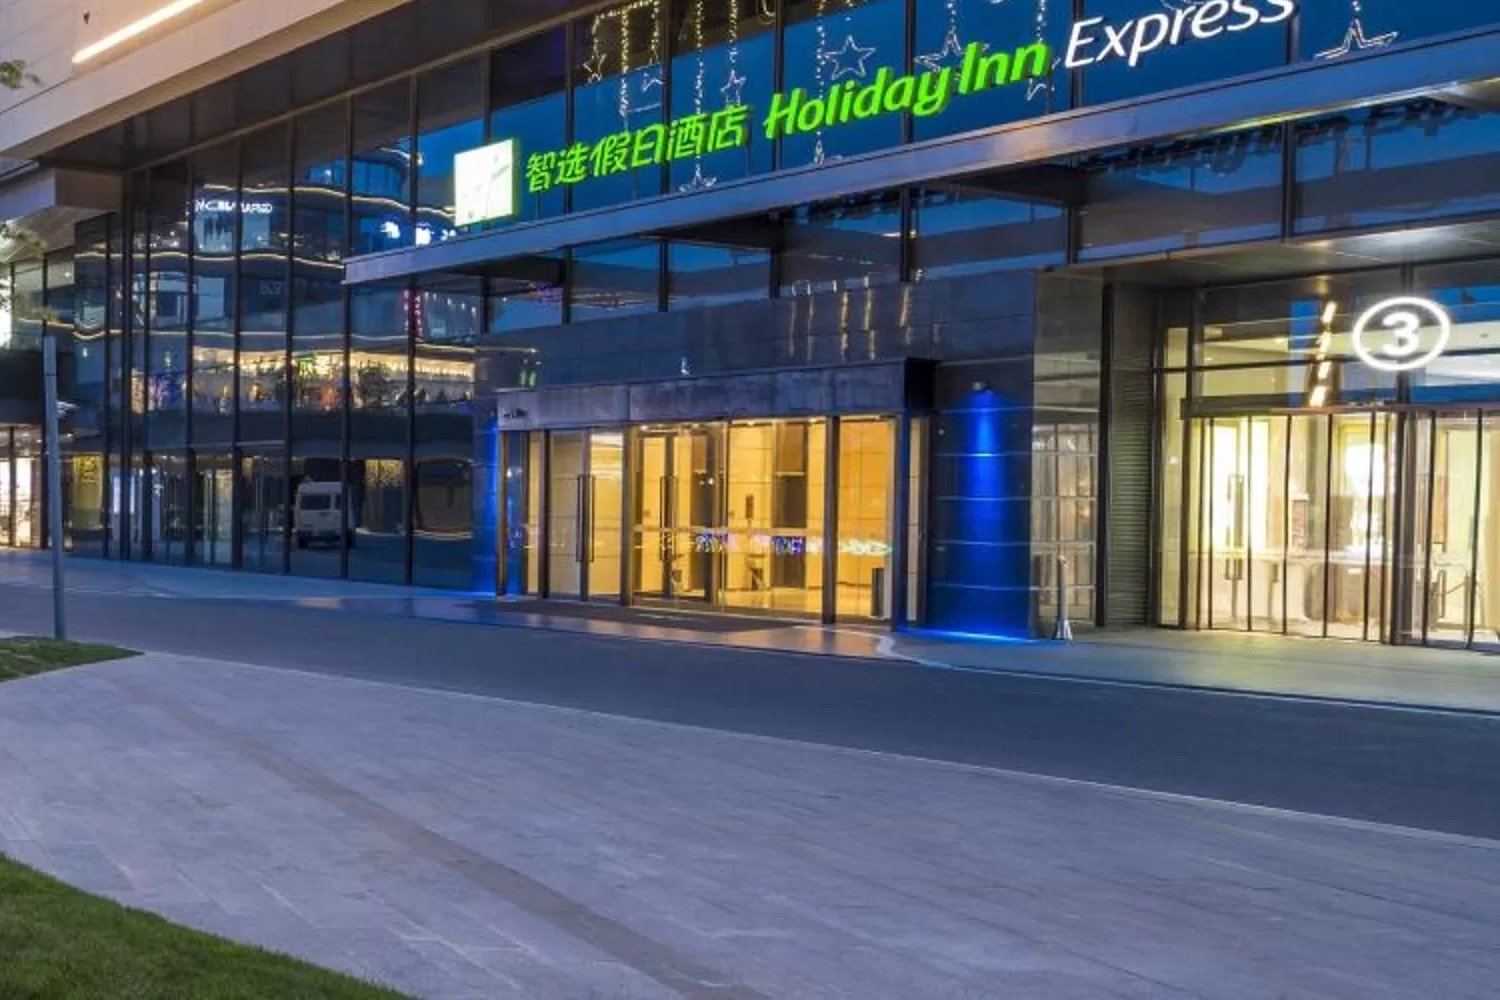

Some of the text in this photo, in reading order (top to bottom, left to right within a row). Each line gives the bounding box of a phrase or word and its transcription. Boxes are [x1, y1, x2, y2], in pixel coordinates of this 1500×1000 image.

[764, 66, 952, 139] Holiday
[957, 42, 1051, 95] Inn
[526, 105, 748, 193] 智选假日酒店
[1382, 311, 1419, 357] 3
